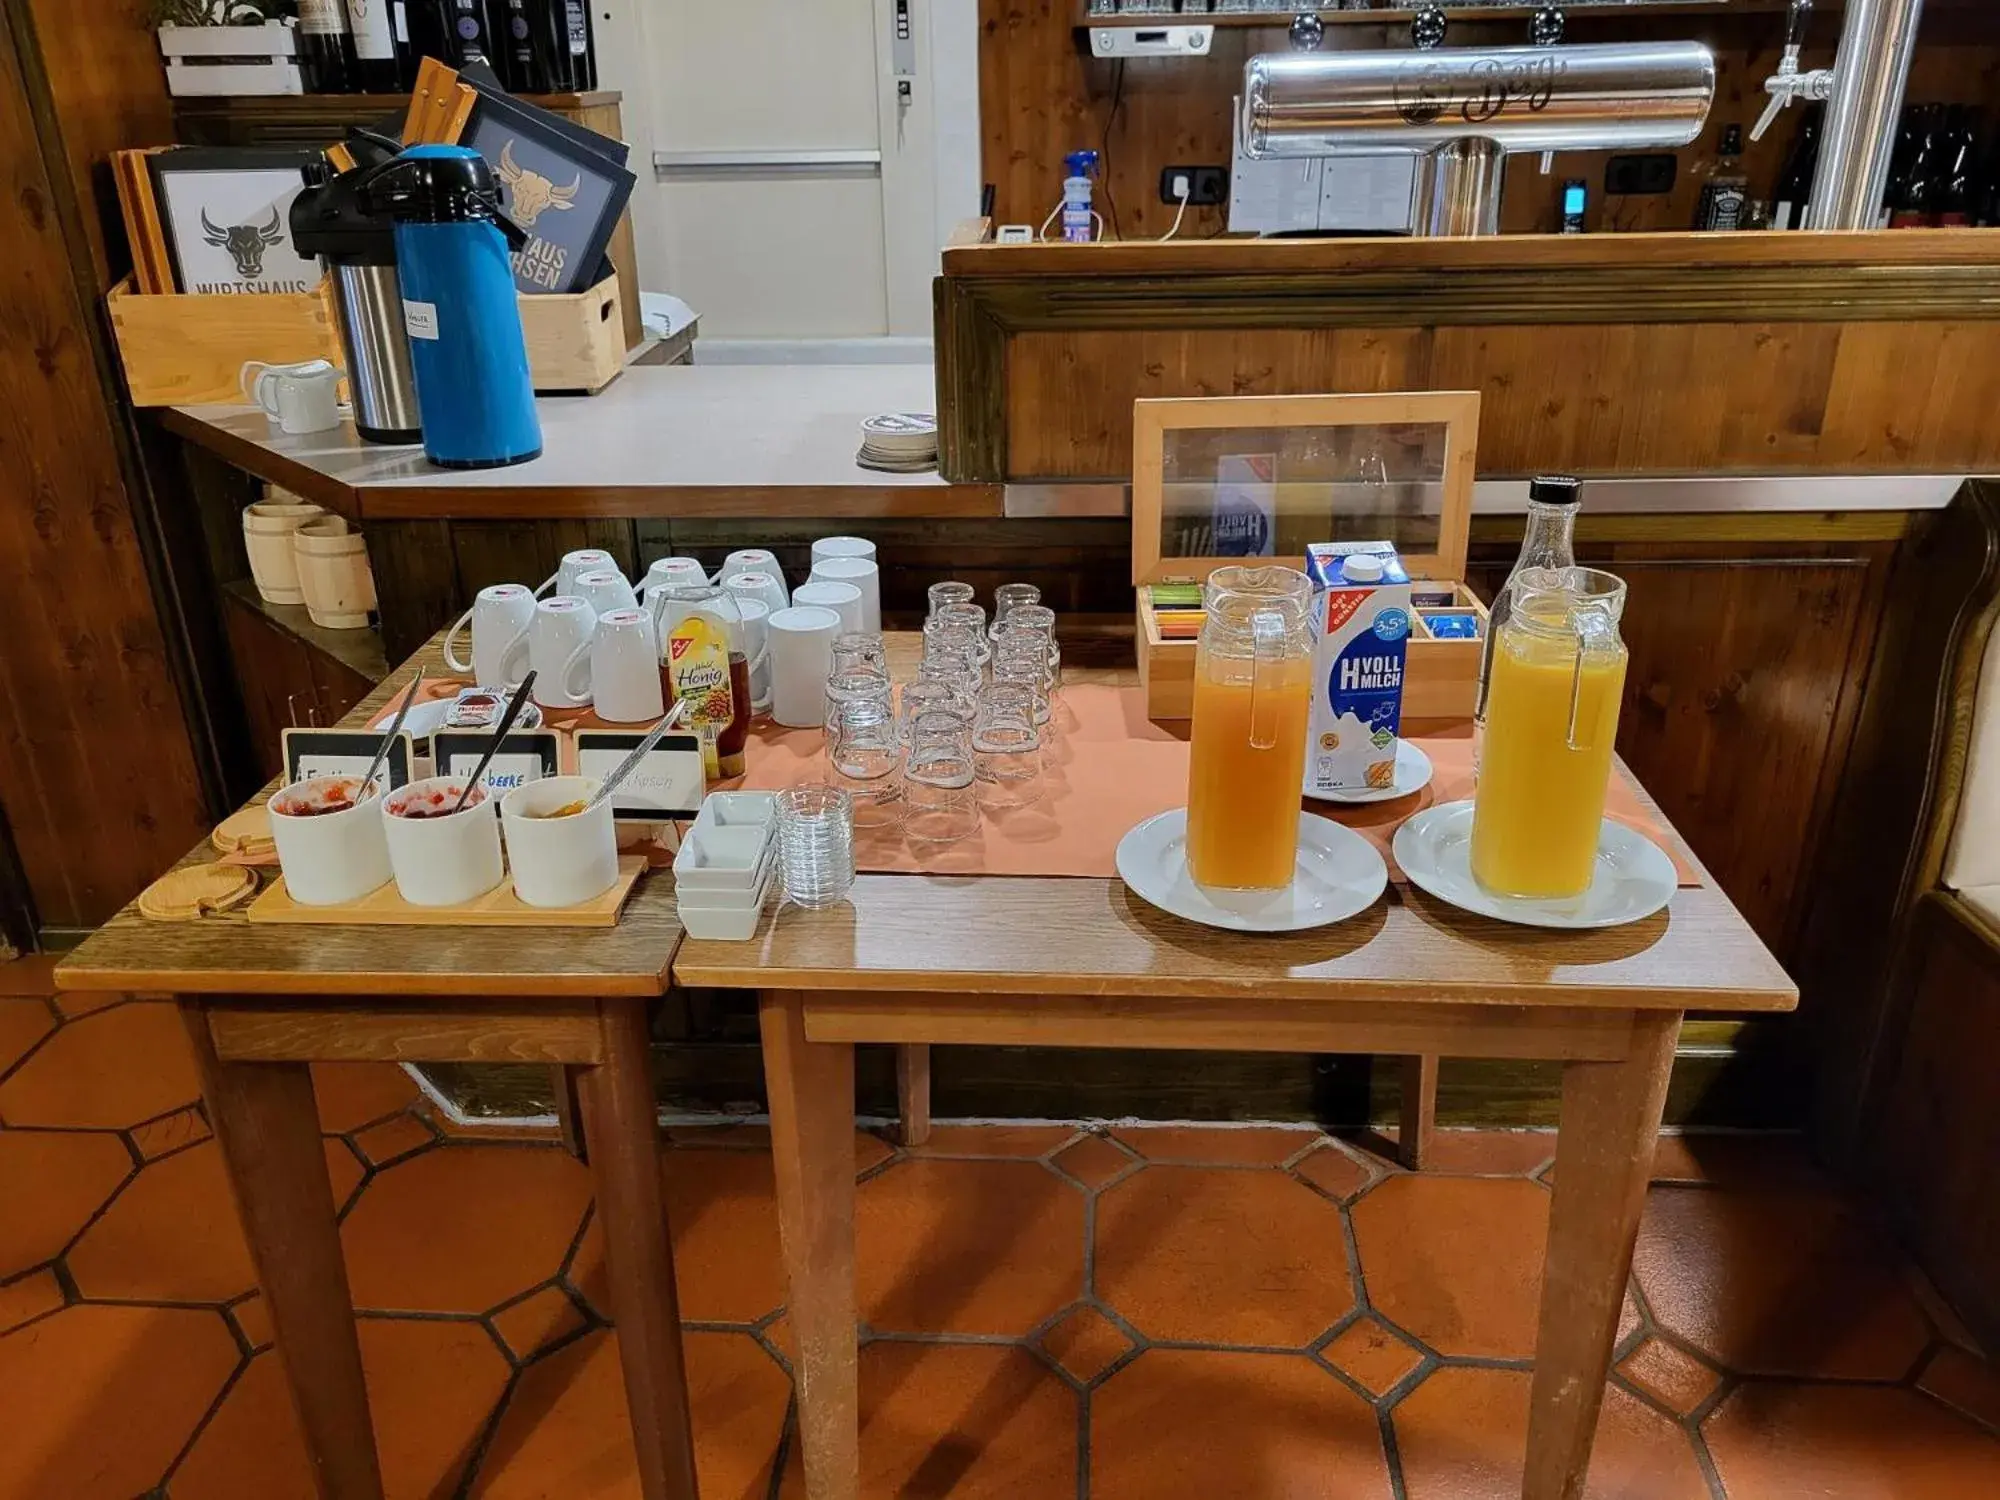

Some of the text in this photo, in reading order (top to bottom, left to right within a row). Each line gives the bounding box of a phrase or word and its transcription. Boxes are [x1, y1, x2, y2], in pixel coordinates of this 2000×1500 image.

[677, 667, 722, 687] Honig
[1340, 655, 1401, 690] H VOLL
[1360, 672, 1401, 689] MILCH
